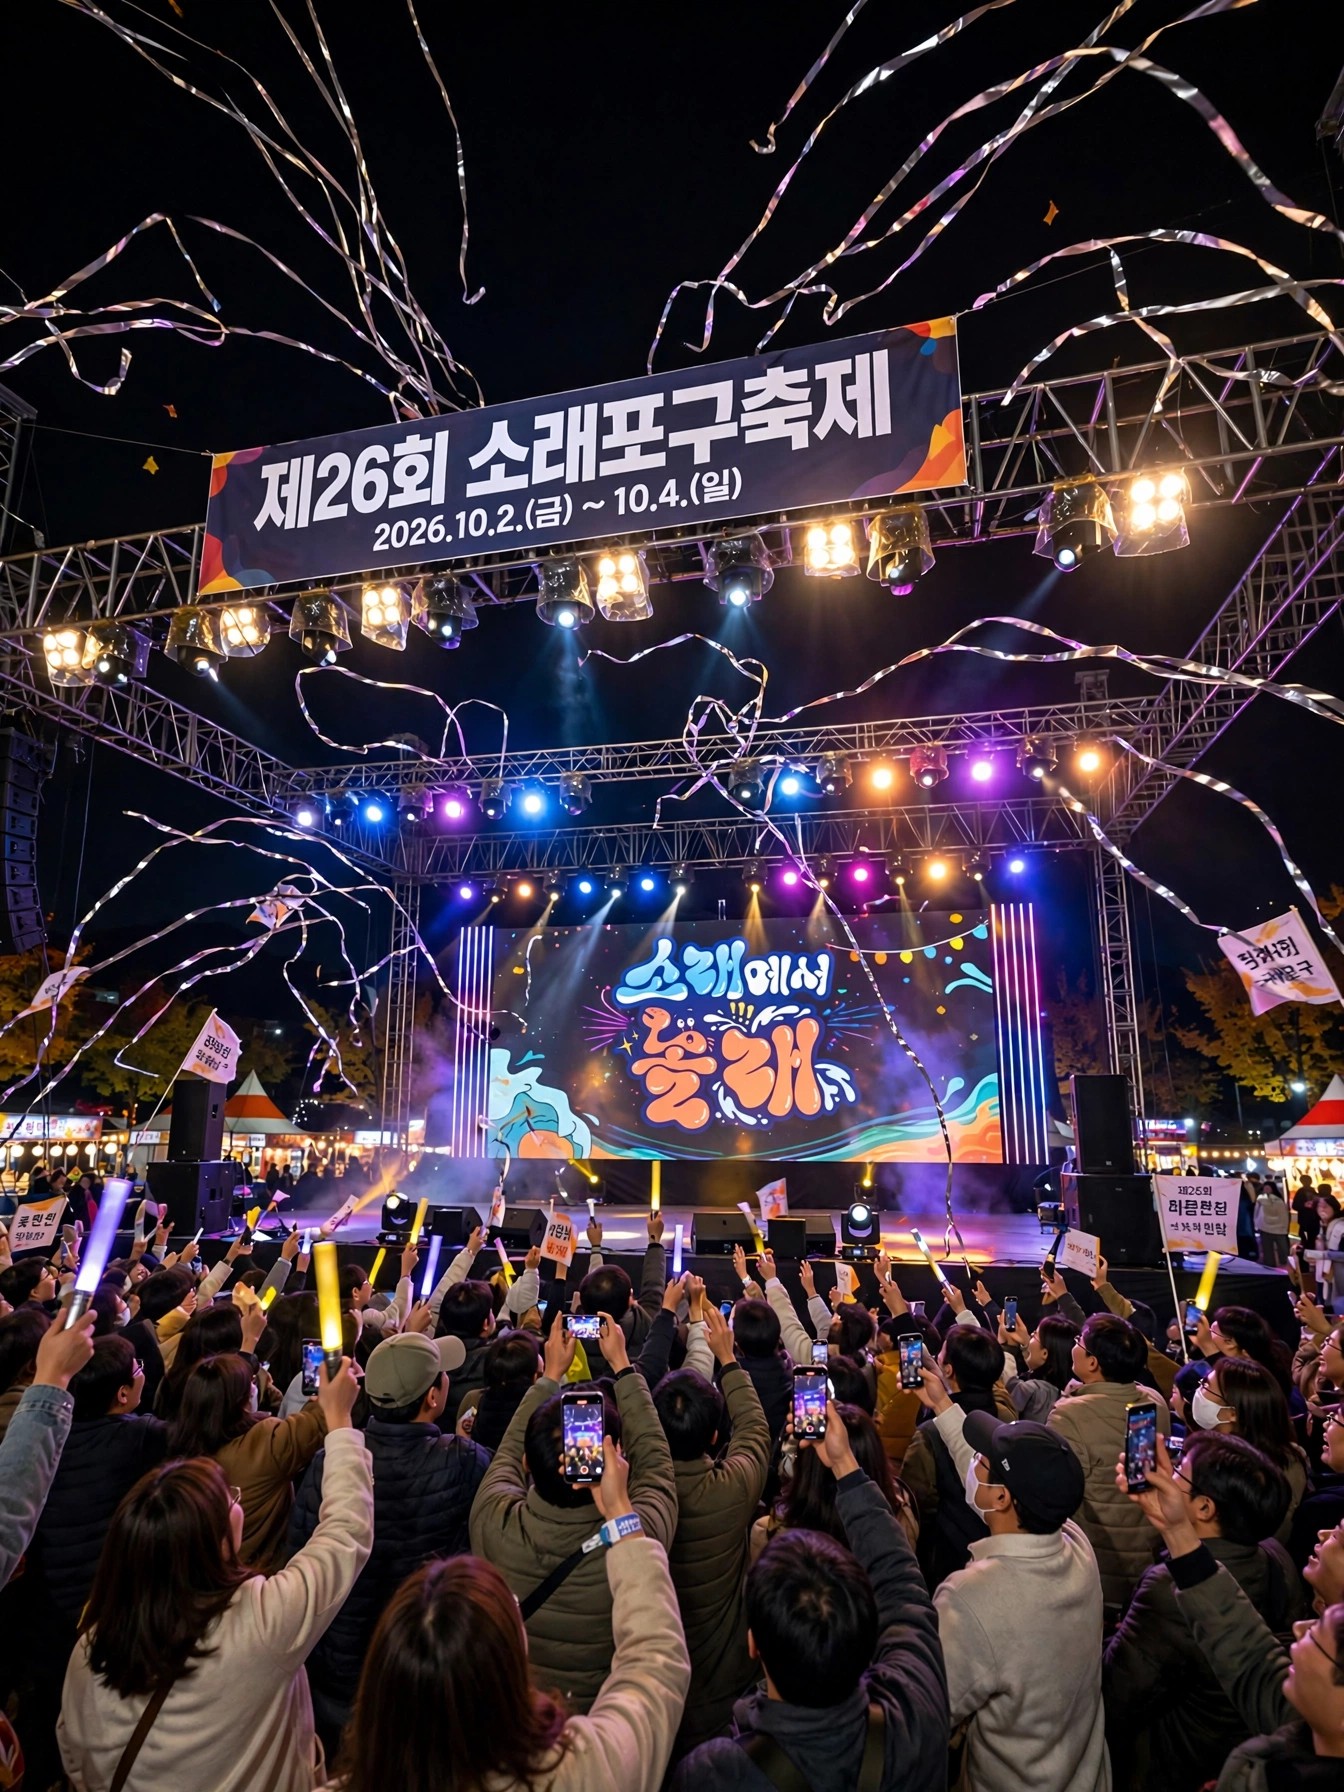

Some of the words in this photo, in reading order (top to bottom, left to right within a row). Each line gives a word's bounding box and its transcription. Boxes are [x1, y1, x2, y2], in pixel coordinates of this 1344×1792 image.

[254, 430, 450, 532] 제26회
[465, 348, 892, 498] 소래포구축제
[373, 493, 574, 552] 2026.10.2.(금)
[614, 467, 742, 516] 10.4.(일)
[615, 938, 830, 1004] 소래에서
[631, 1006, 822, 1129] 놀래
